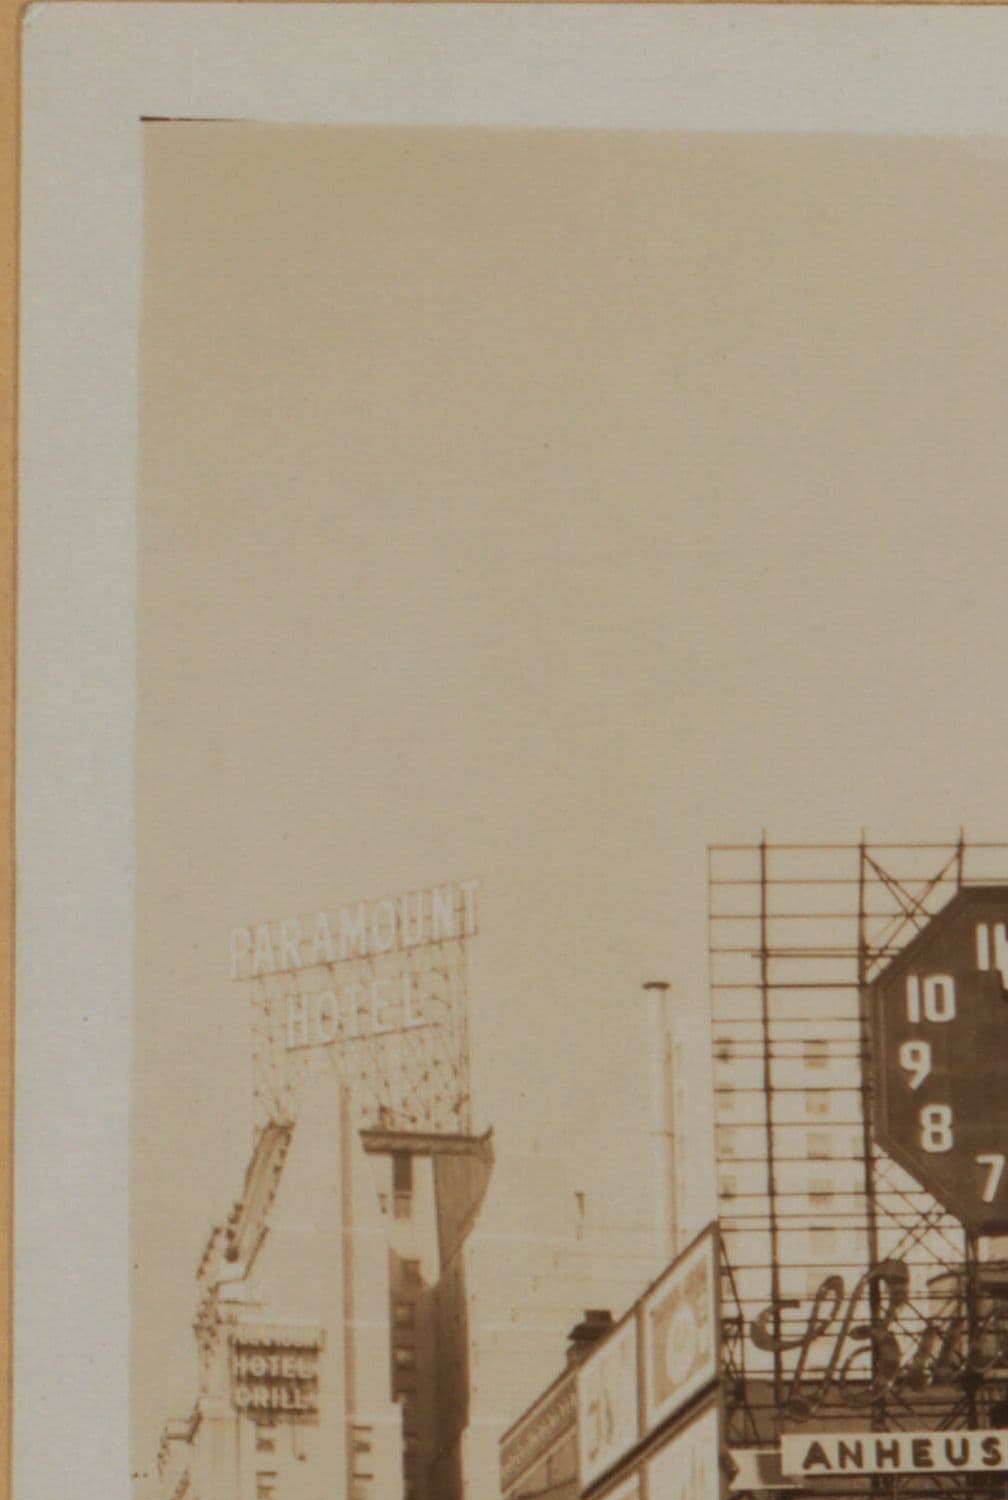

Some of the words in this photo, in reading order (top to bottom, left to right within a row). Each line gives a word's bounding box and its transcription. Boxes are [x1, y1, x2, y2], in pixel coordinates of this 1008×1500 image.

[232, 881, 479, 978] PARAMOUNT
[286, 980, 424, 1048] HOTEL
[906, 975, 956, 1023] 10
[900, 1041, 932, 1090] 9
[920, 1104, 953, 1153] 8
[976, 1155, 1005, 1202] 7
